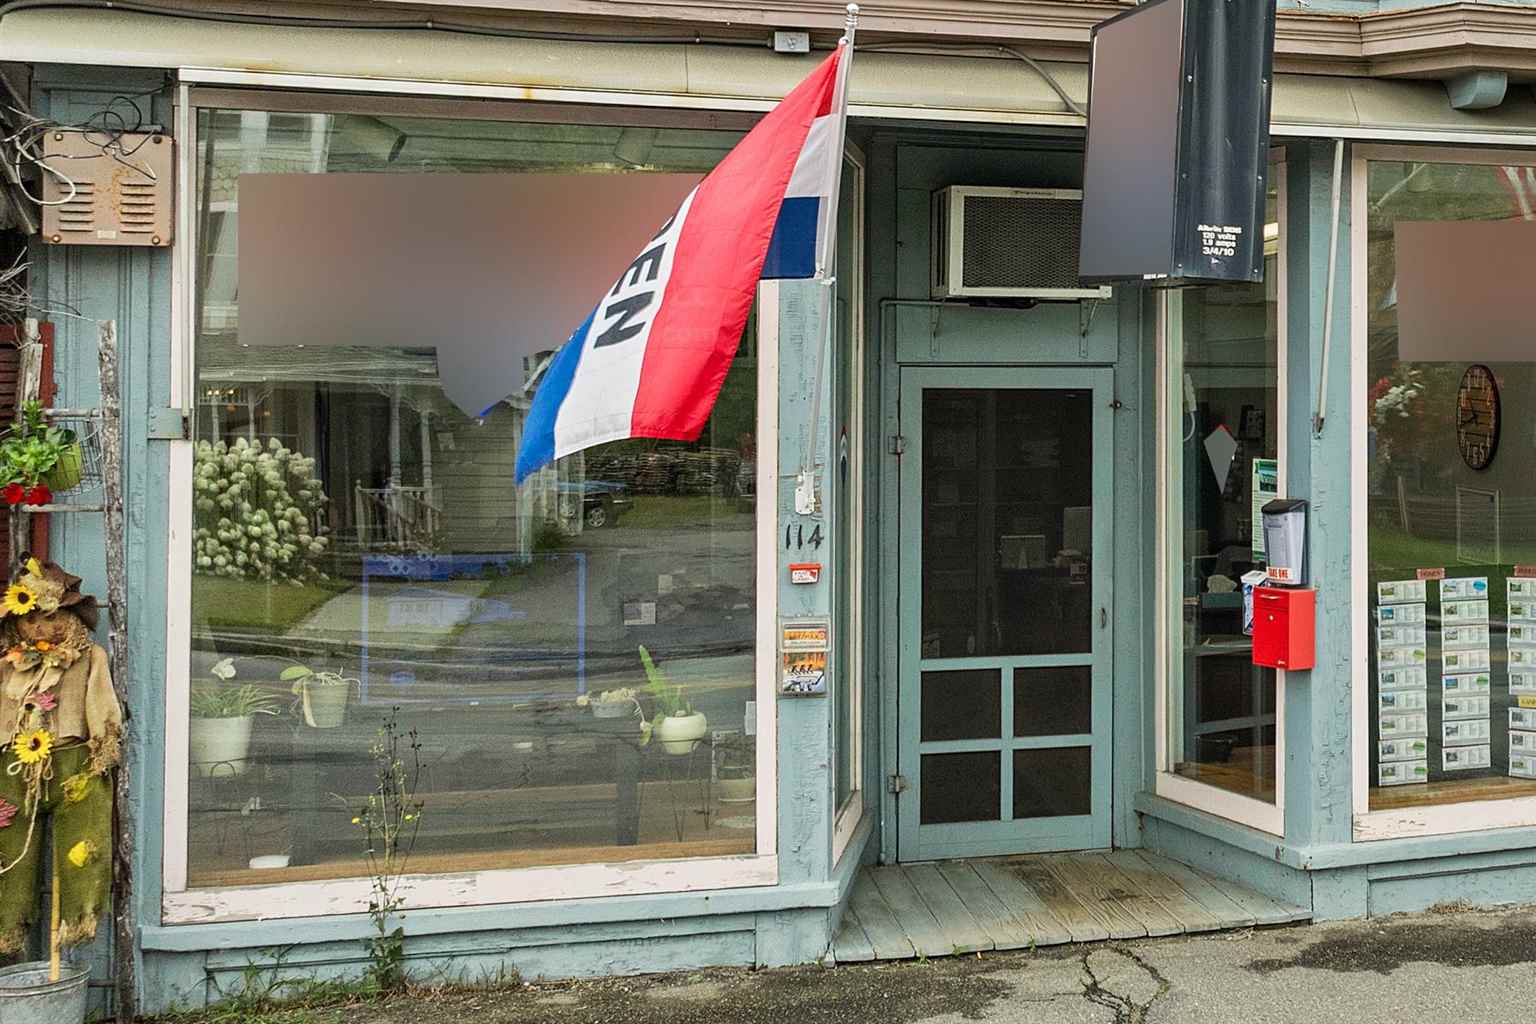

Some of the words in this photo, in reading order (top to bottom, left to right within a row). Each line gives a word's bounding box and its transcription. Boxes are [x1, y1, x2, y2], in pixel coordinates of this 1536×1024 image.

[1202, 246, 1234, 256] 3/4/10
[593, 202, 685, 349] EN
[786, 524, 824, 550] 114
